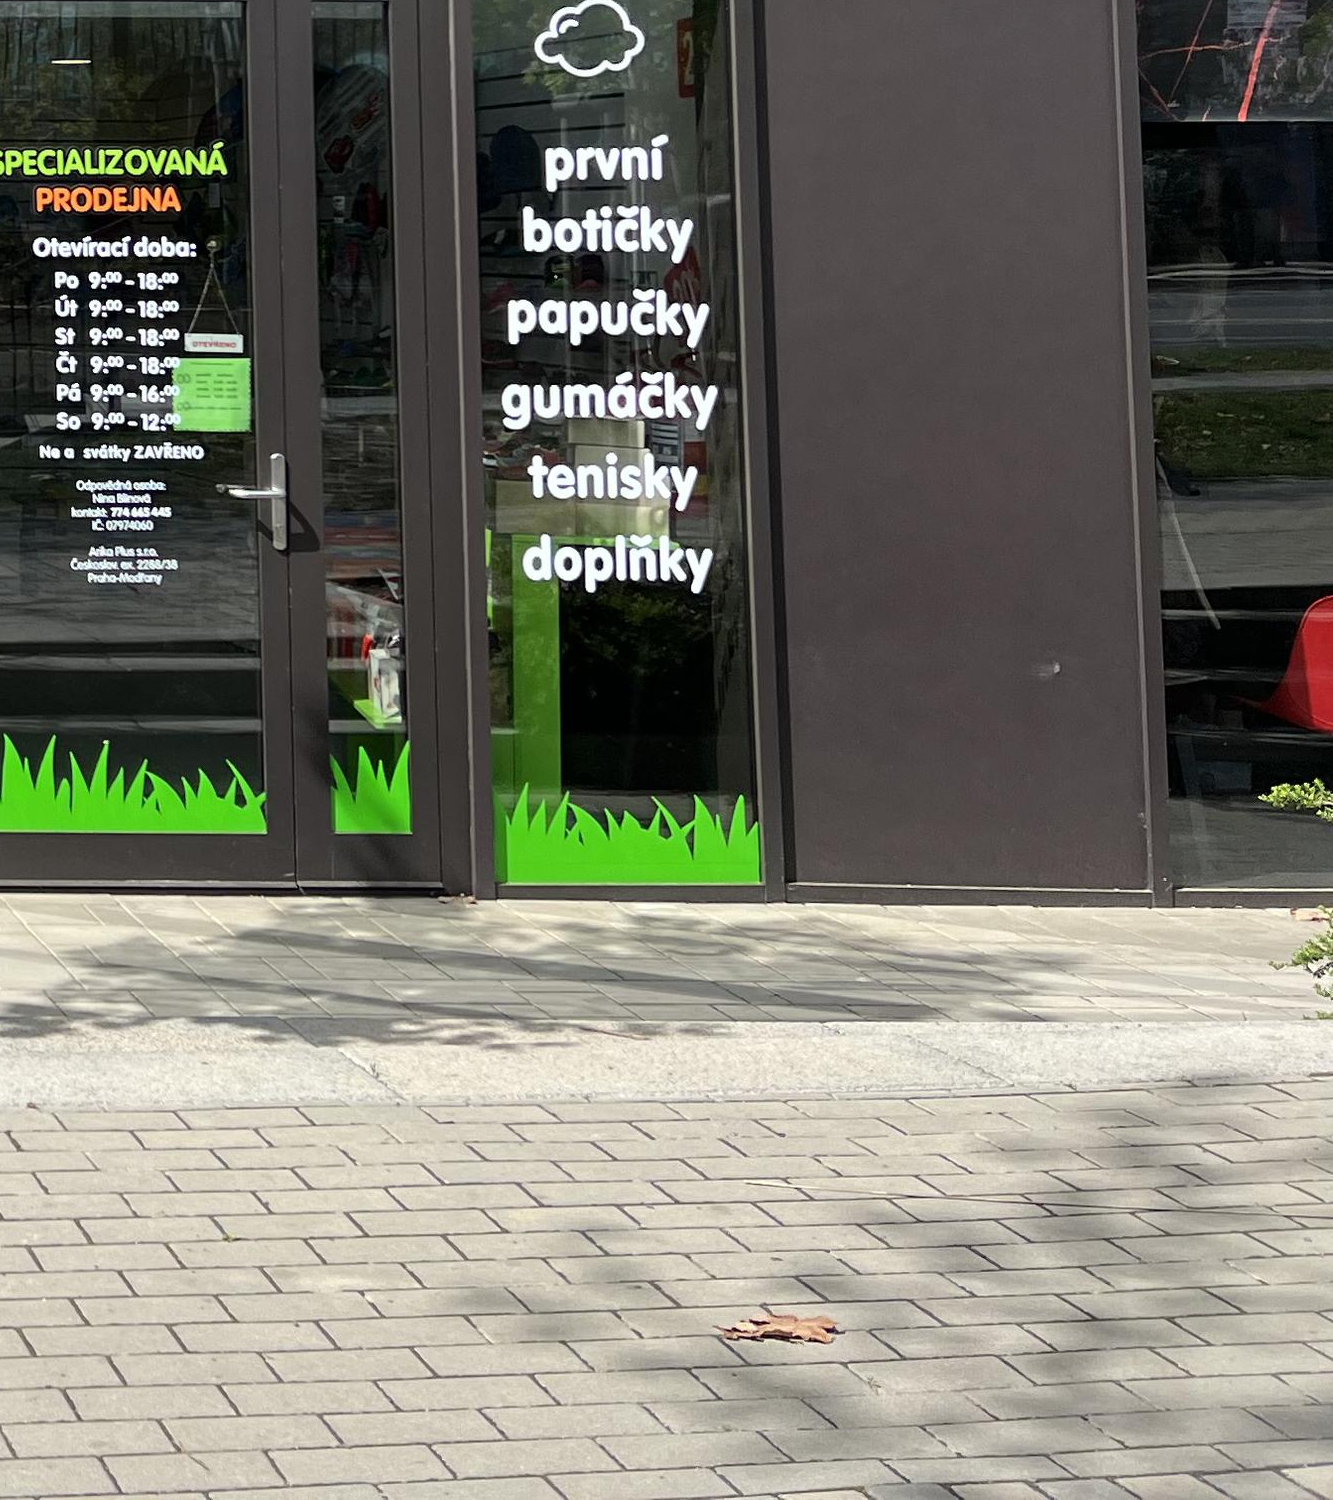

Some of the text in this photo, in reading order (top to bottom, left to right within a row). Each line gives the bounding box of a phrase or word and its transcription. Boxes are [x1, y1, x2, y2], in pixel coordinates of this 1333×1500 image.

[544, 134, 669, 192] první
[37, 187, 181, 212] PRODEJNA
[521, 204, 694, 264] botičky
[33, 236, 196, 257] Otevírací doba:
[55, 272, 79, 289] Po
[55, 295, 78, 317] Út
[505, 288, 711, 348] papučky
[55, 327, 75, 345] St
[56, 351, 77, 373] Čt
[57, 383, 81, 401] Pá
[500, 371, 719, 431] gumáčky
[57, 412, 81, 430] So
[39, 440, 205, 463] Ne a svátky ZAVŘENO
[526, 452, 699, 512] tenisky
[521, 533, 714, 594] doplňky
